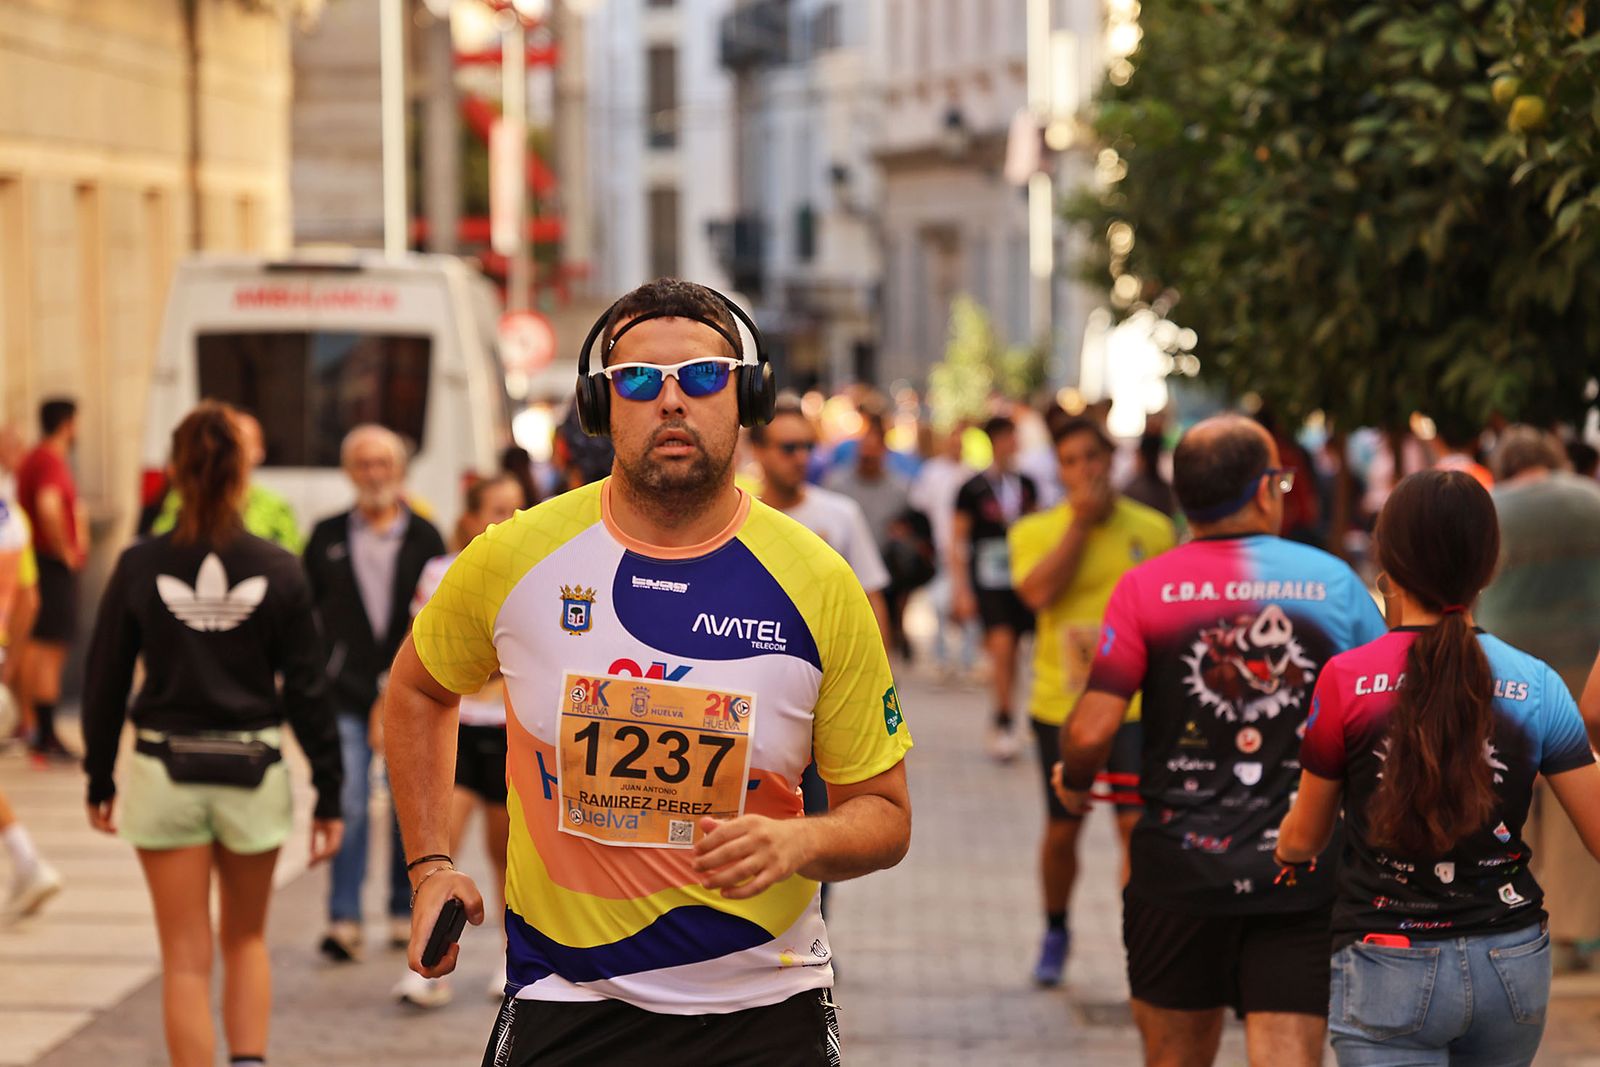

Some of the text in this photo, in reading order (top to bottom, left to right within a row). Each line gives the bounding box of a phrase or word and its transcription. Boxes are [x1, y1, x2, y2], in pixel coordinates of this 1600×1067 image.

[1225, 580, 1326, 603] CORRALES
[692, 613, 787, 643] AVATEL
[751, 641, 786, 651] TELECOM
[571, 702, 609, 716] HUELVA
[651, 708, 684, 718] HUELVA
[703, 717, 740, 730] HUELVA
[574, 721, 735, 787] 1237
[620, 784, 677, 796] JUAN ANTONIO
[579, 791, 713, 815] RAMIREZ PEREZ
